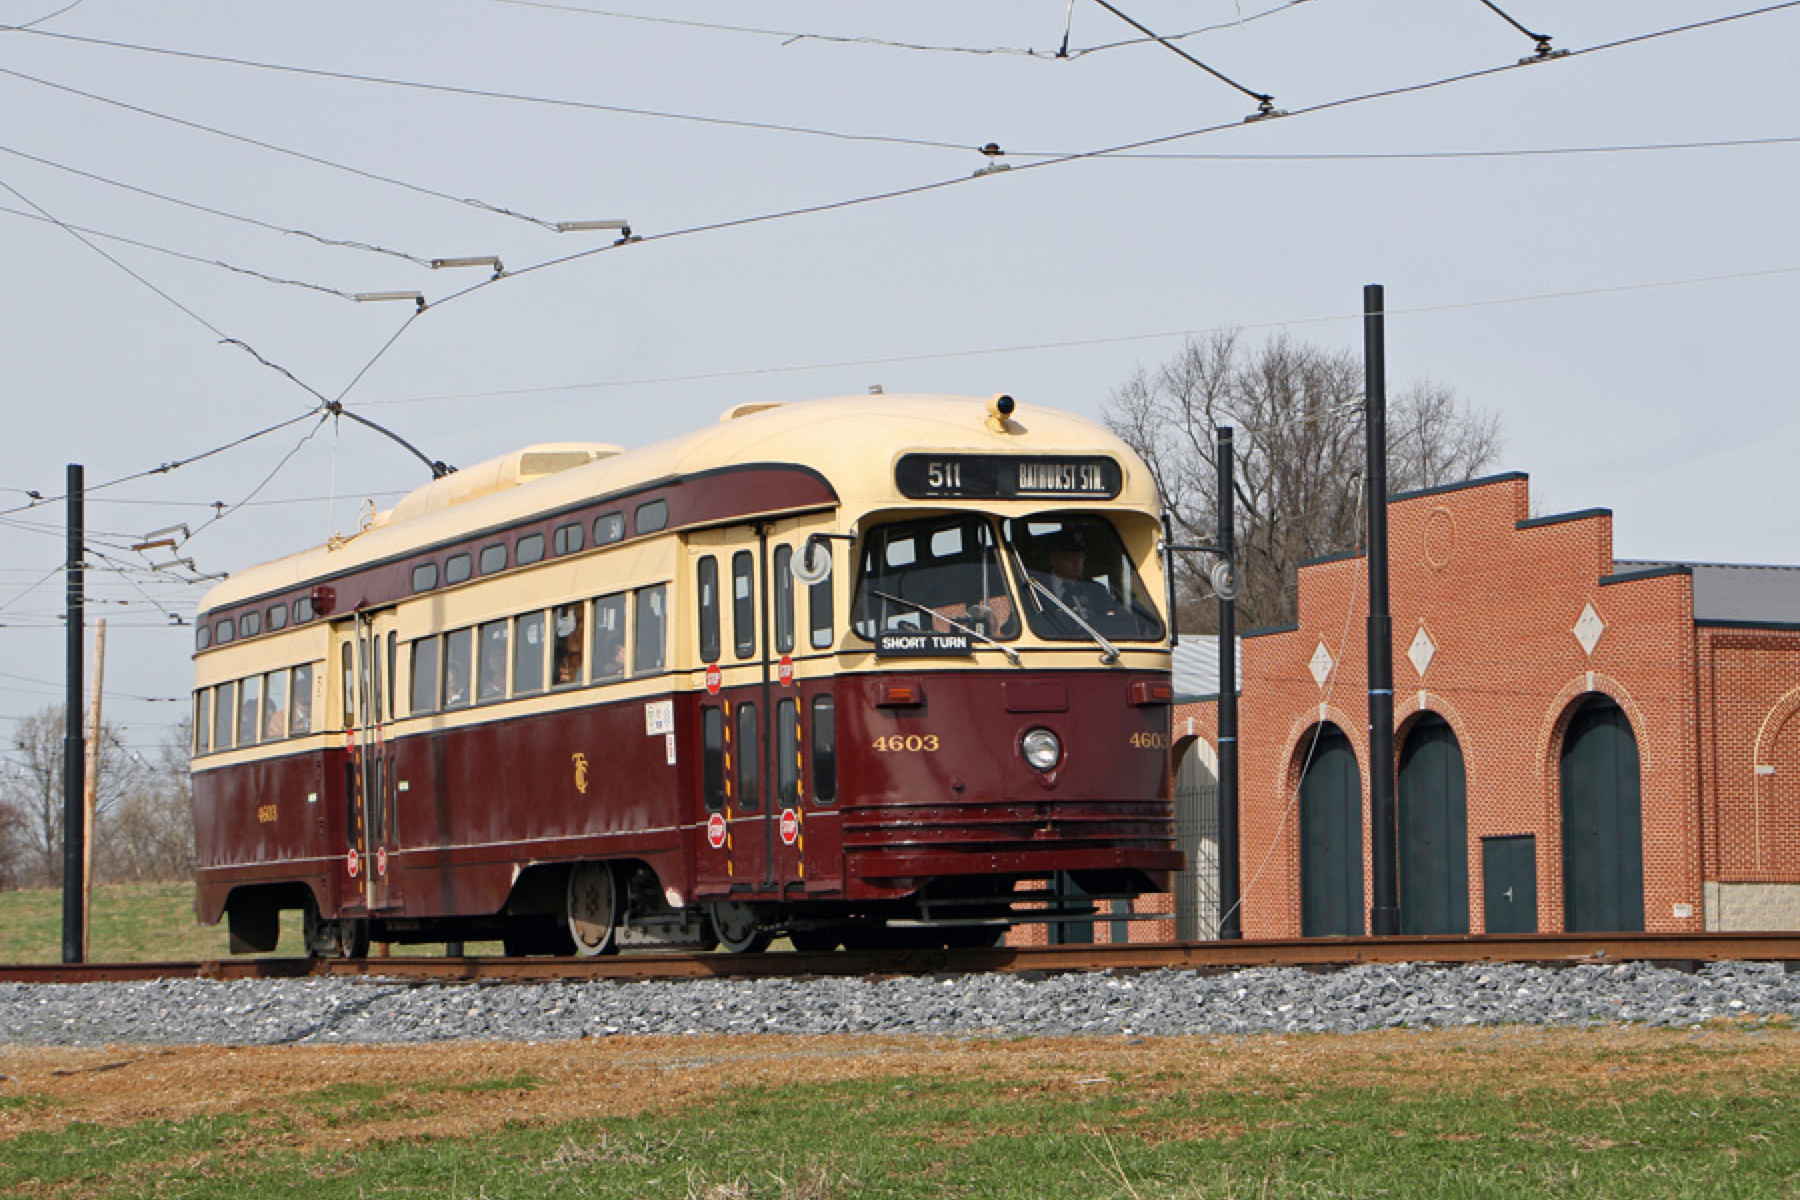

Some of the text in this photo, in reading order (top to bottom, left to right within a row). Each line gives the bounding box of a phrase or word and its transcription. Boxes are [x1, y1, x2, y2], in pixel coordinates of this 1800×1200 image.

[928, 463, 961, 488] 511
[882, 636, 967, 649] SHORT TURN
[871, 734, 940, 752] 4603
